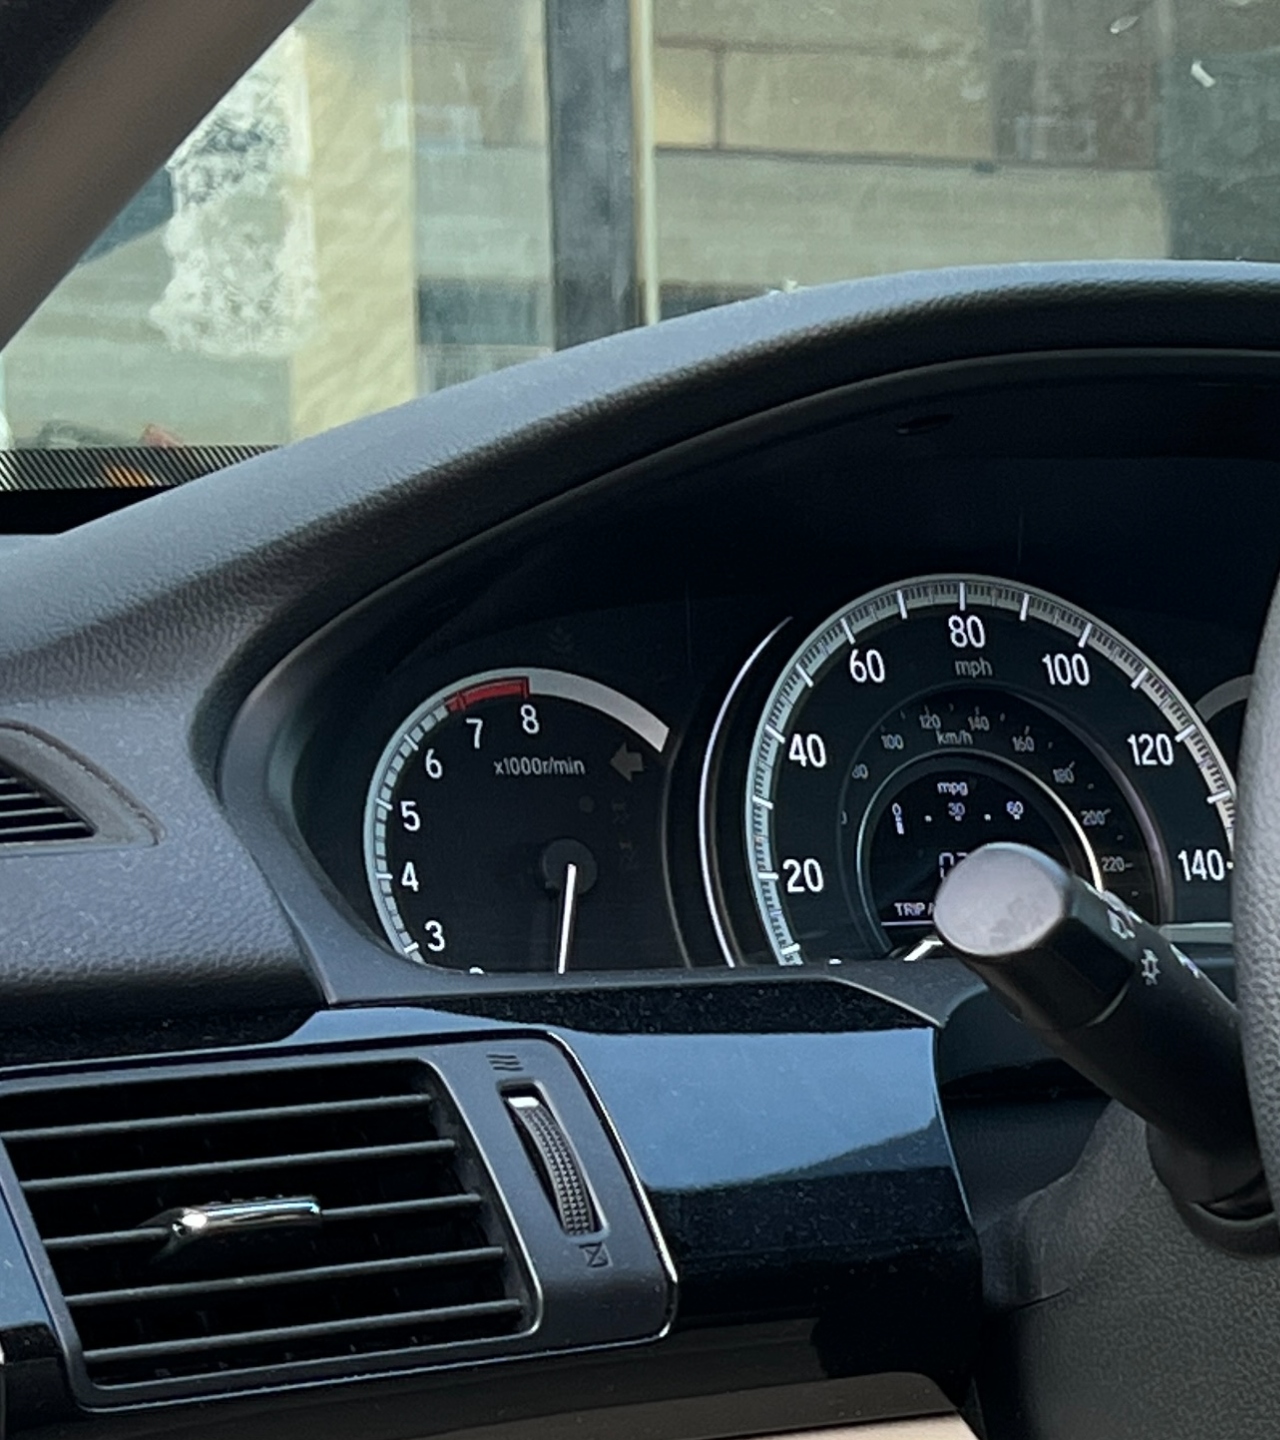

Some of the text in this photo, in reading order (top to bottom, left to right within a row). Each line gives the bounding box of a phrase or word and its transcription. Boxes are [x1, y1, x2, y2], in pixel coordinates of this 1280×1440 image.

[948, 615, 986, 648] 80
[849, 650, 885, 683] 60
[955, 657, 992, 679] mph
[1042, 653, 1090, 686] 100
[465, 718, 484, 749] 7
[520, 704, 540, 734] 8
[919, 714, 941, 730] 120
[967, 716, 990, 731] 140
[788, 734, 827, 768] 40
[881, 734, 904, 750] 100
[936, 730, 973, 746] km/h
[1127, 733, 1174, 766] 120
[425, 749, 443, 780] 6
[494, 756, 586, 776] x1000r/min
[937, 781, 969, 797] mpg
[400, 801, 421, 832] 5
[401, 862, 419, 892] 4
[783, 858, 823, 892] 20
[1177, 849, 1226, 881] 140
[894, 902, 925, 916] TRIP
[424, 920, 445, 951] 3
